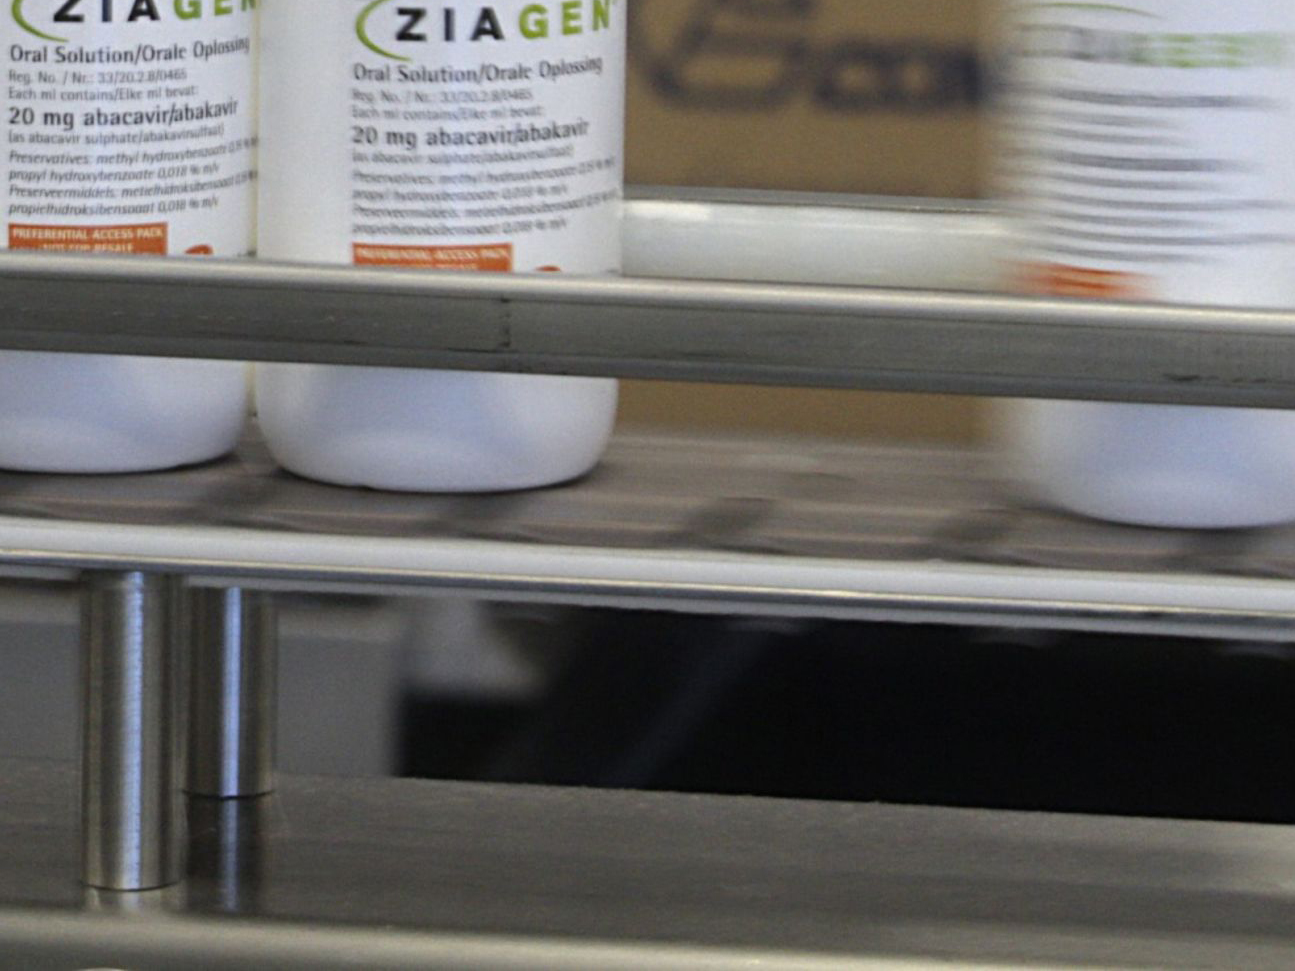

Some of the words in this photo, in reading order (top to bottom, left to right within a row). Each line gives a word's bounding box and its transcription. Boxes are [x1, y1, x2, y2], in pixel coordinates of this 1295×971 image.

[10, 44, 47, 64] Oral
[56, 42, 186, 65] Solution/Orale
[193, 36, 250, 60] Oplossing
[353, 62, 391, 82] Oral
[398, 62, 532, 84] Solution/Orale
[538, 56, 604, 82] Oplossing
[8, 87, 37, 100] Each
[41, 87, 56, 99] ml
[60, 86, 143, 101] contains/Elke
[8, 107, 35, 126] 20
[43, 110, 74, 129] mg
[83, 97, 239, 127] abacavir/abakavir
[28, 131, 80, 144] abacavir
[352, 125, 378, 145] 20
[386, 128, 418, 150] mg
[426, 117, 590, 147] abacavir/abakavir
[11, 227, 88, 241] PREFERENTIAL
[92, 228, 134, 240] ACCESS
